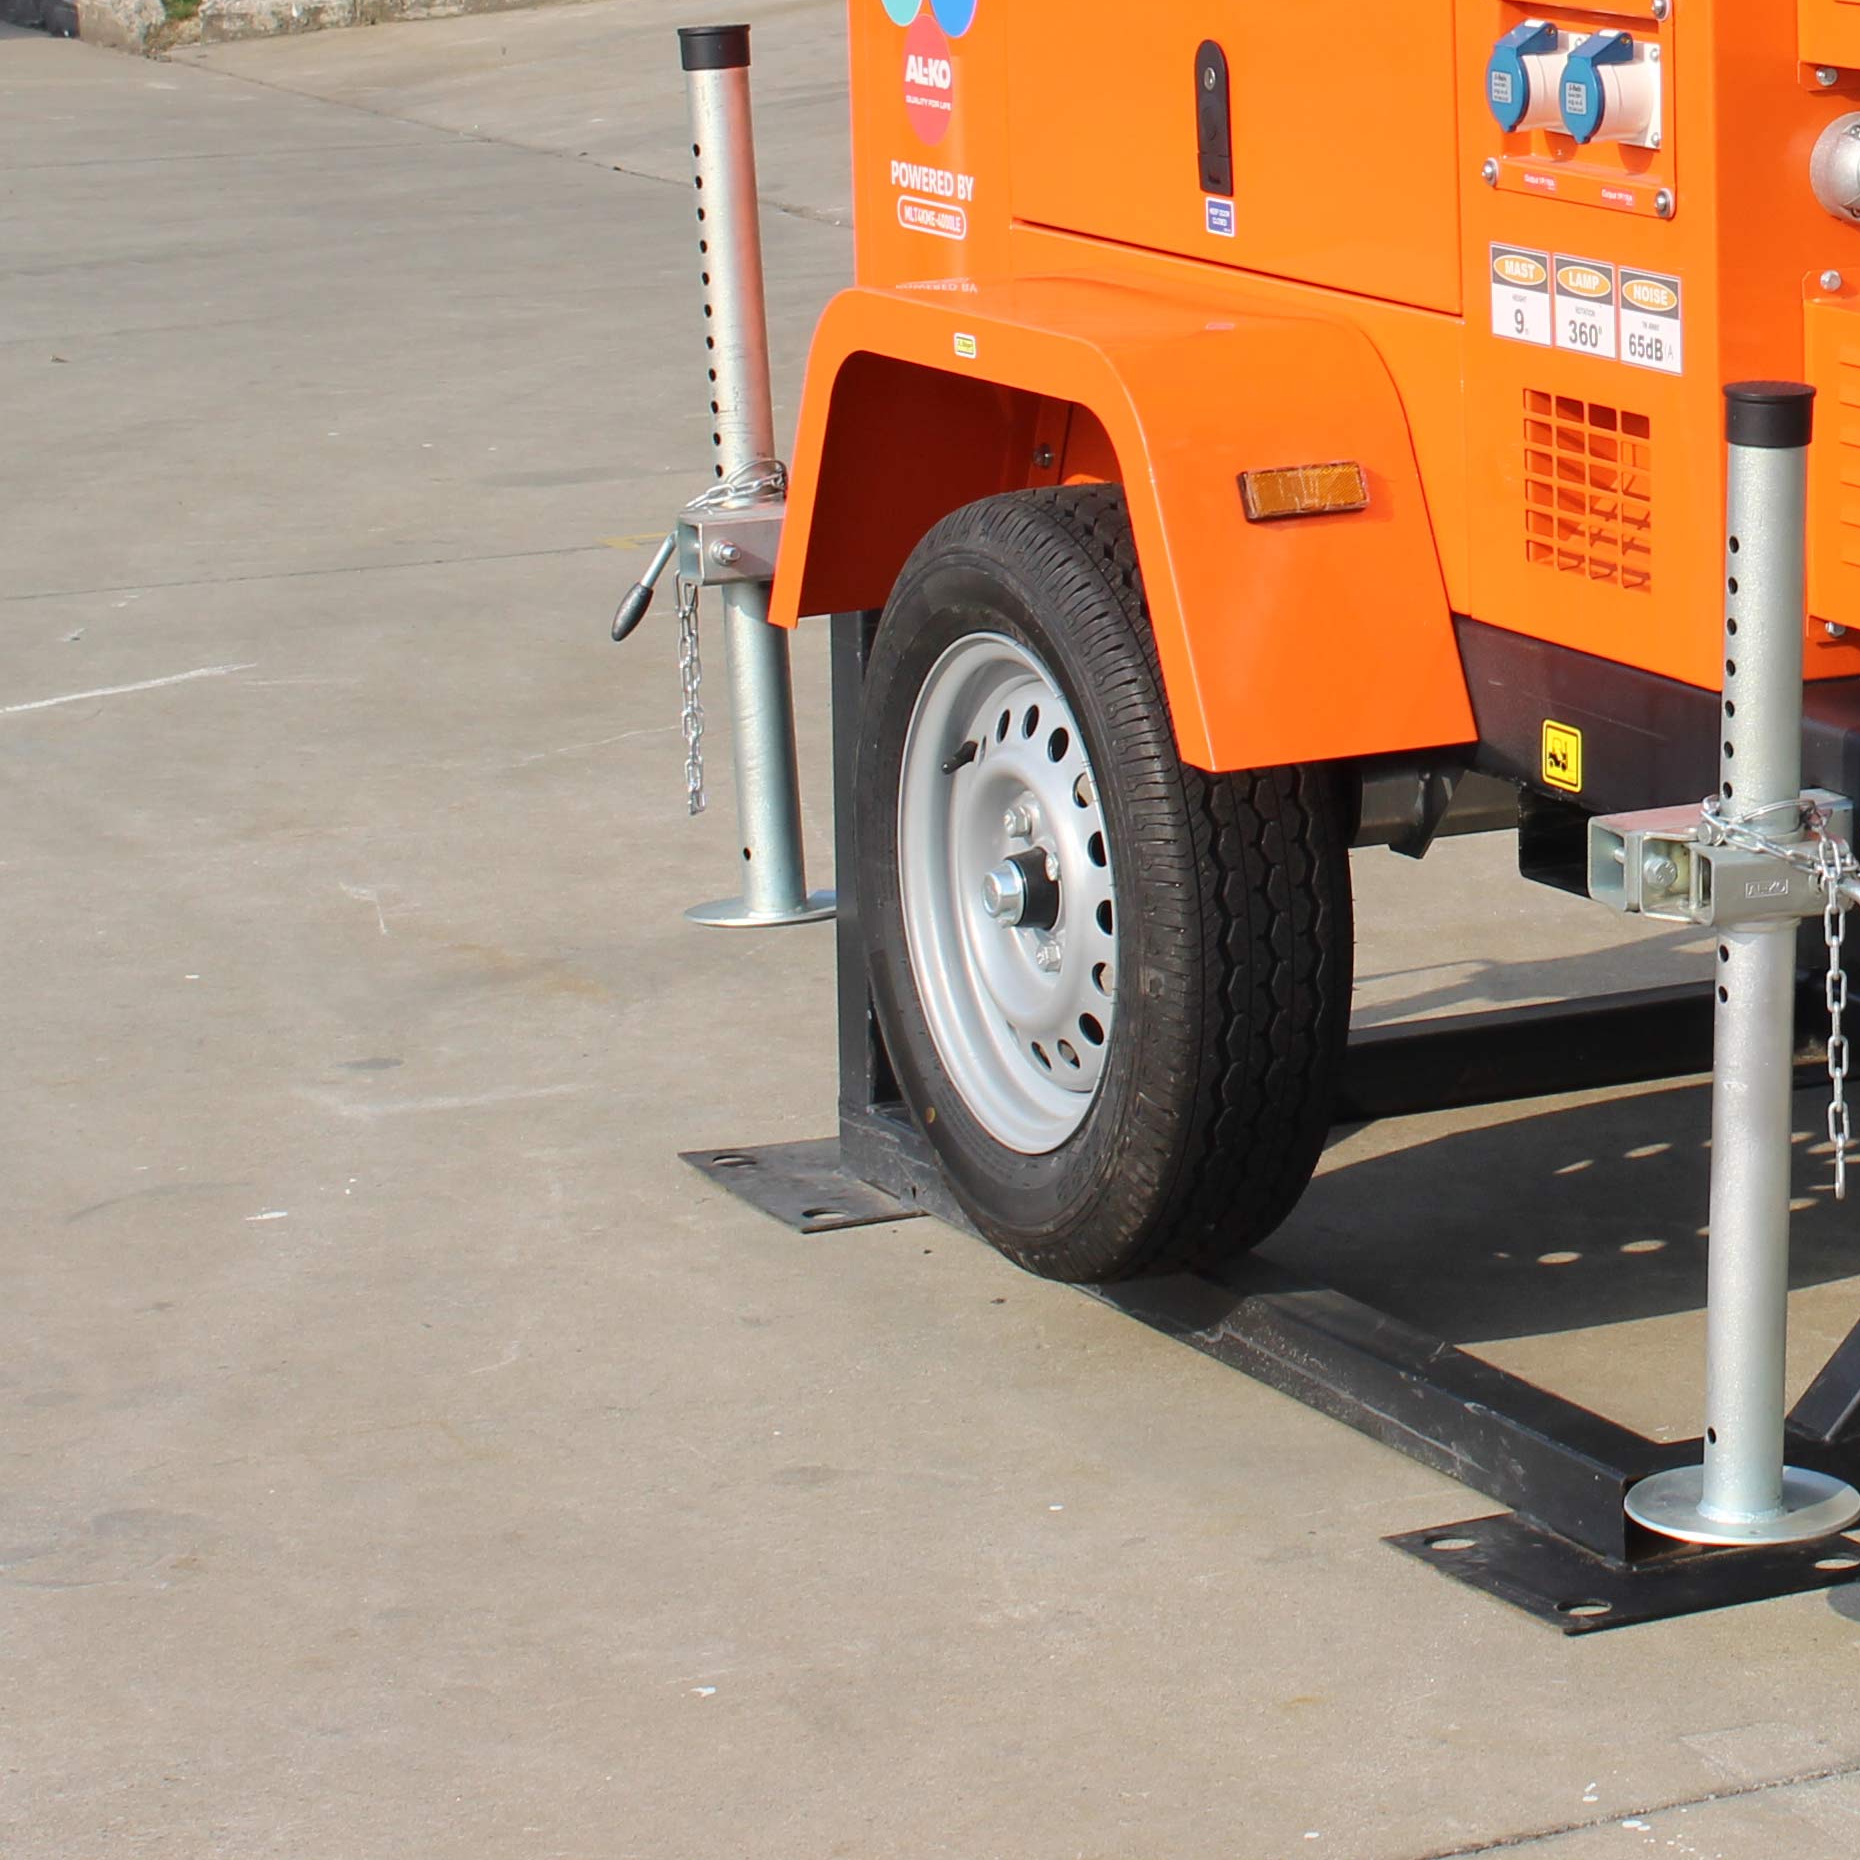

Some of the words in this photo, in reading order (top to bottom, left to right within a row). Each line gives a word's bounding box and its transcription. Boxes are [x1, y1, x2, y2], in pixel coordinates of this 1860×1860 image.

[890, 159, 954, 198] POWERED
[957, 174, 975, 202] BY
[1504, 258, 1536, 281] MAST
[1568, 271, 1600, 292] LAMP
[1632, 283, 1669, 306] NOISE
